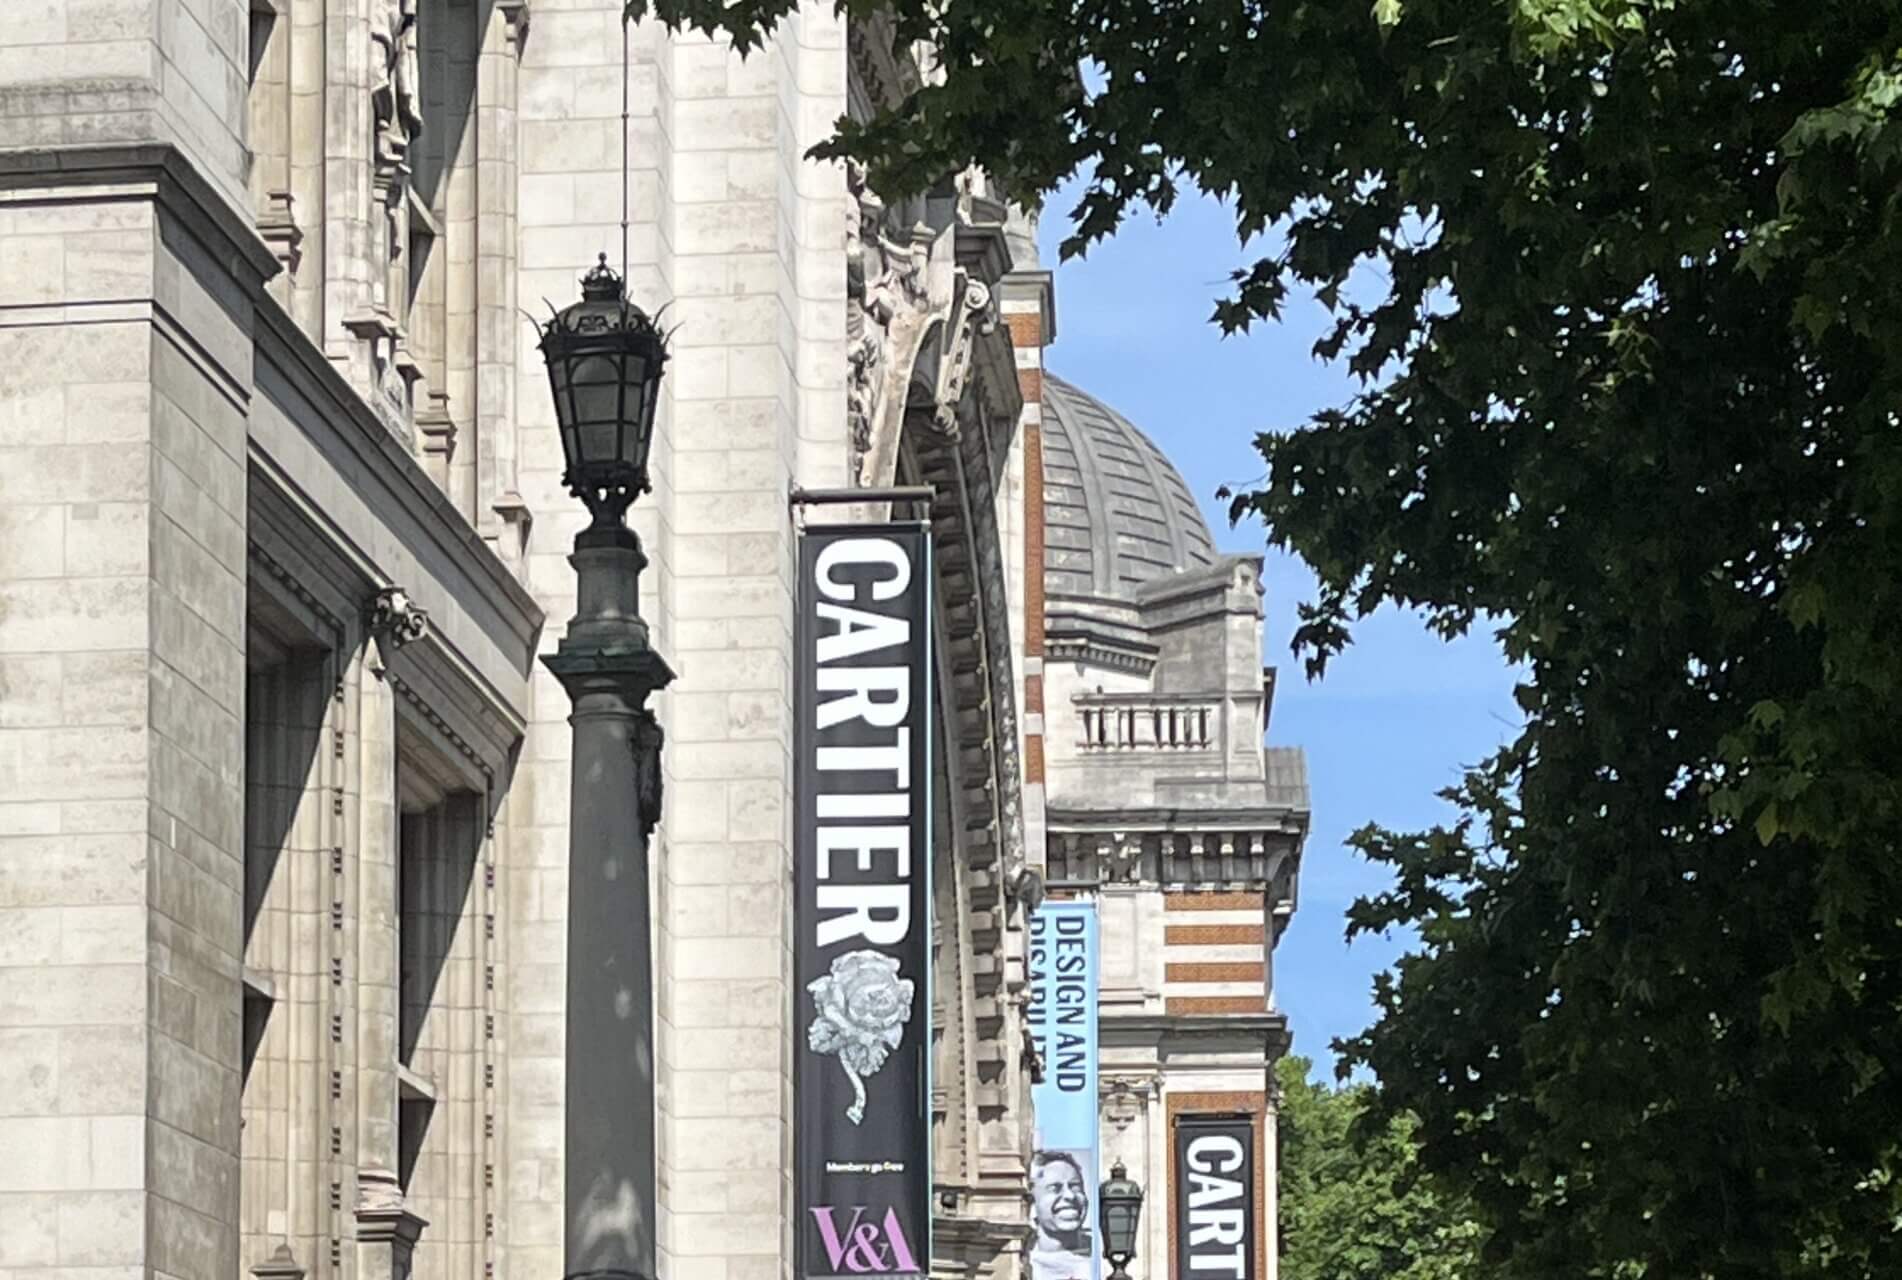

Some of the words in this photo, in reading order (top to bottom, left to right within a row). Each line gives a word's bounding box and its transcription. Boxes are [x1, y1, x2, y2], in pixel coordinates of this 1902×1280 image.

[815, 537, 912, 948] CARTIER
[1055, 915, 1087, 1025] DESIGN
[1055, 1030, 1087, 1093] AND
[808, 1205, 921, 1273] V&A
